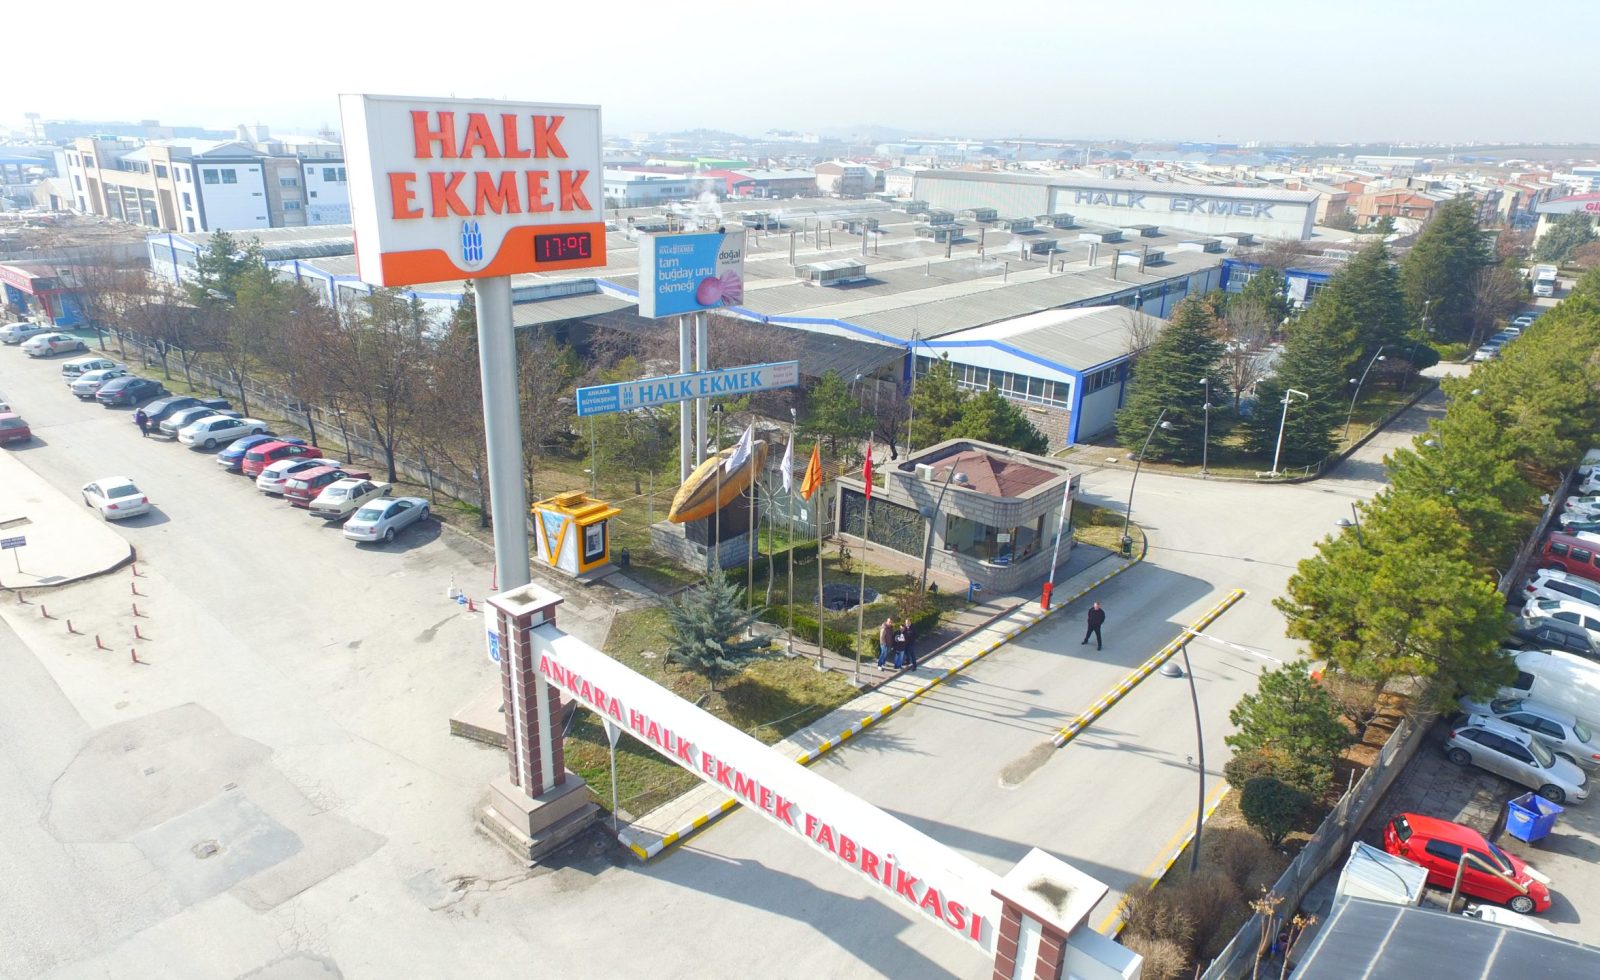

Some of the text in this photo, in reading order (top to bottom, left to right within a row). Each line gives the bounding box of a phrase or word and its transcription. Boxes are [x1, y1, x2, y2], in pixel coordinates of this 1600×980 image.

[410, 110, 569, 160] HALK
[387, 170, 593, 219] EKMEK
[1075, 189, 1274, 218] HALK EKMEK
[659, 257, 679, 268] tam
[719, 249, 741, 261] doğal
[659, 267, 713, 282] buğday unu
[659, 281, 695, 294] ekmeği
[639, 370, 763, 403] HALK EKMEK
[539, 655, 983, 942] ANKARA HALK EKMEK FABRİKASI
